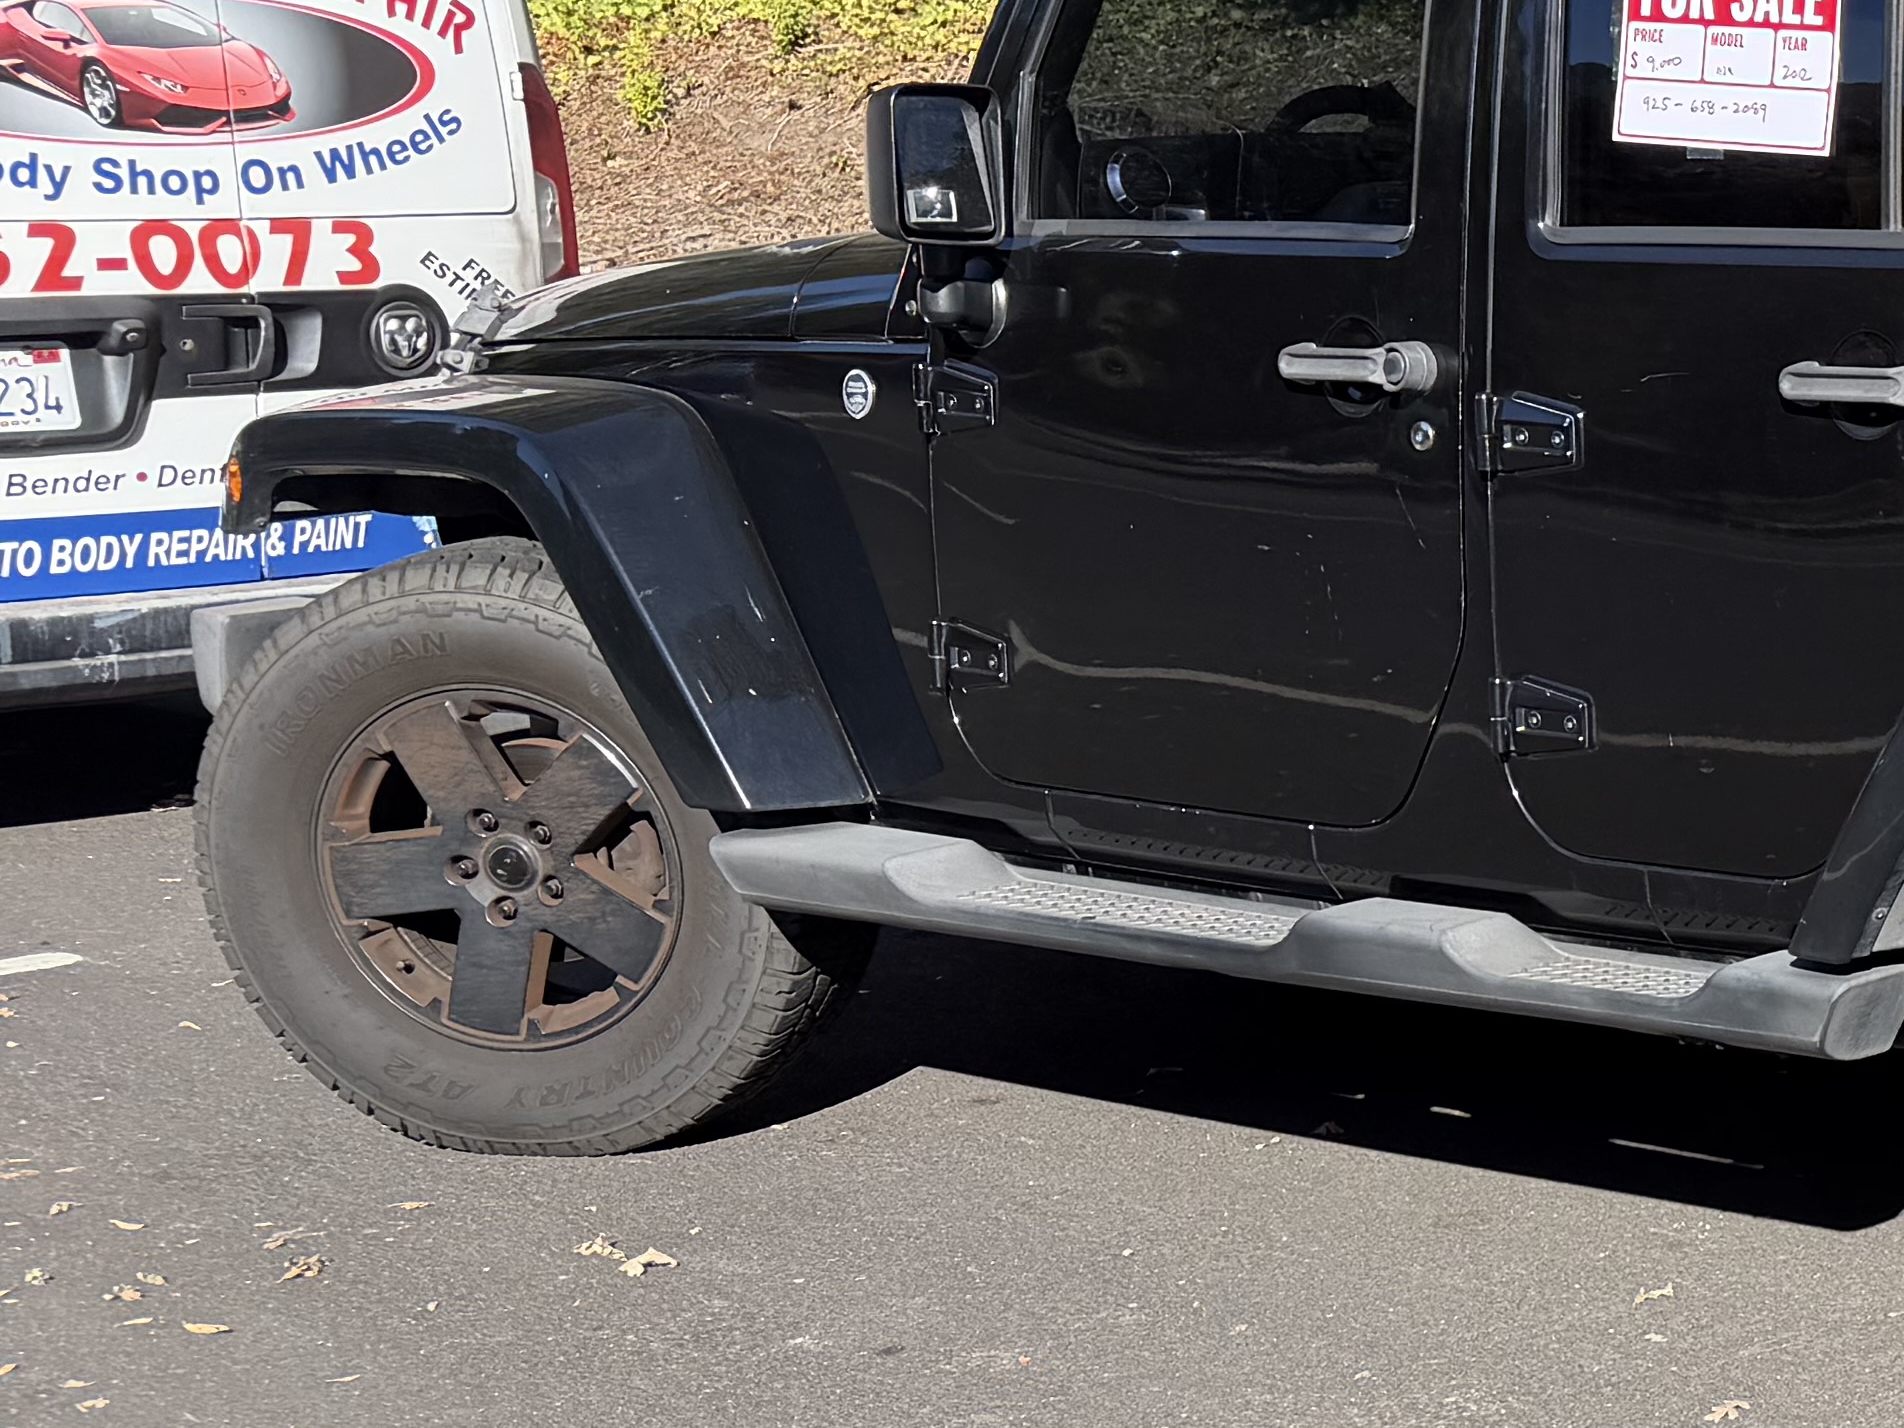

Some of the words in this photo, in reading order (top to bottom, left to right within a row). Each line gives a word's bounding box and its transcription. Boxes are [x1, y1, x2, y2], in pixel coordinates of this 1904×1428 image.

[1634, 28, 1664, 44] PRICE
[1711, 32, 1744, 48] MODEL
[1782, 36, 1808, 51] YEAR
[0, 152, 73, 202] dy
[92, 156, 221, 205] Shop
[241, 158, 304, 197] On
[313, 107, 463, 185] Wheels
[0, 219, 381, 293] 2-0073
[5, 469, 126, 498] Bender
[49, 533, 143, 575] BODY
[147, 527, 257, 568] REPAIR
[266, 526, 285, 556] &
[292, 514, 371, 556] PAINT
[264, 629, 451, 758] IRONMAN
